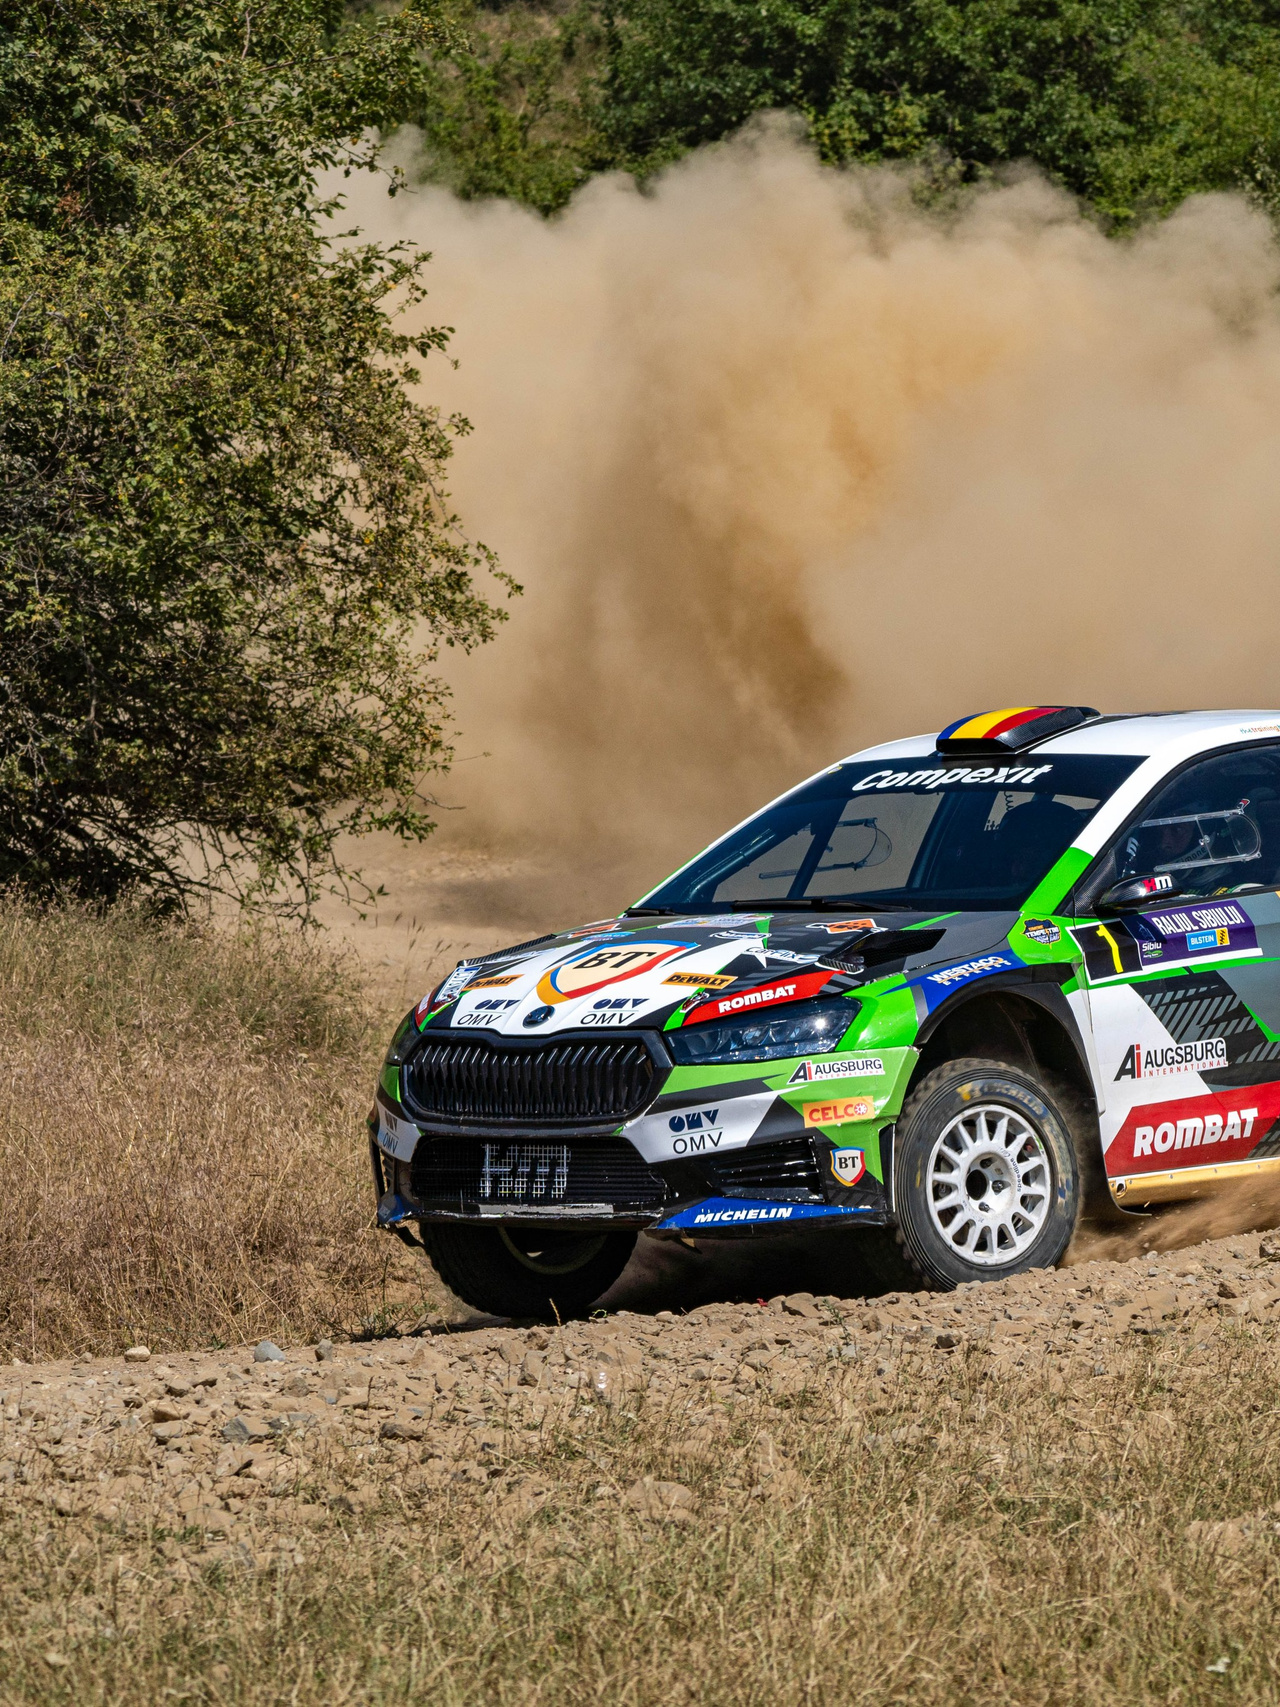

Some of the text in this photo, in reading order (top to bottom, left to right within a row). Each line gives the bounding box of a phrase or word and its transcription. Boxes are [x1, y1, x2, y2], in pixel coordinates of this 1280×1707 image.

[852, 764, 1053, 791] Compexit
[1151, 905, 1246, 936] RALIUL SIBIULUI
[1096, 924, 1124, 974] 1
[1189, 934, 1215, 946] BILSTEIN
[572, 951, 657, 970] BT
[718, 984, 797, 1014] ROMBAT
[457, 1014, 503, 1026] OMV
[580, 1013, 635, 1025] OMV
[1144, 1040, 1225, 1069] AUGSBURG
[814, 1058, 883, 1075] AUGSBURG
[1143, 1060, 1228, 1078] INTERNATIONAL
[1133, 1107, 1258, 1158] ROMBAT
[672, 1132, 723, 1154] OMV
[837, 1156, 859, 1170] BT
[694, 1207, 793, 1224] MICHELIN
